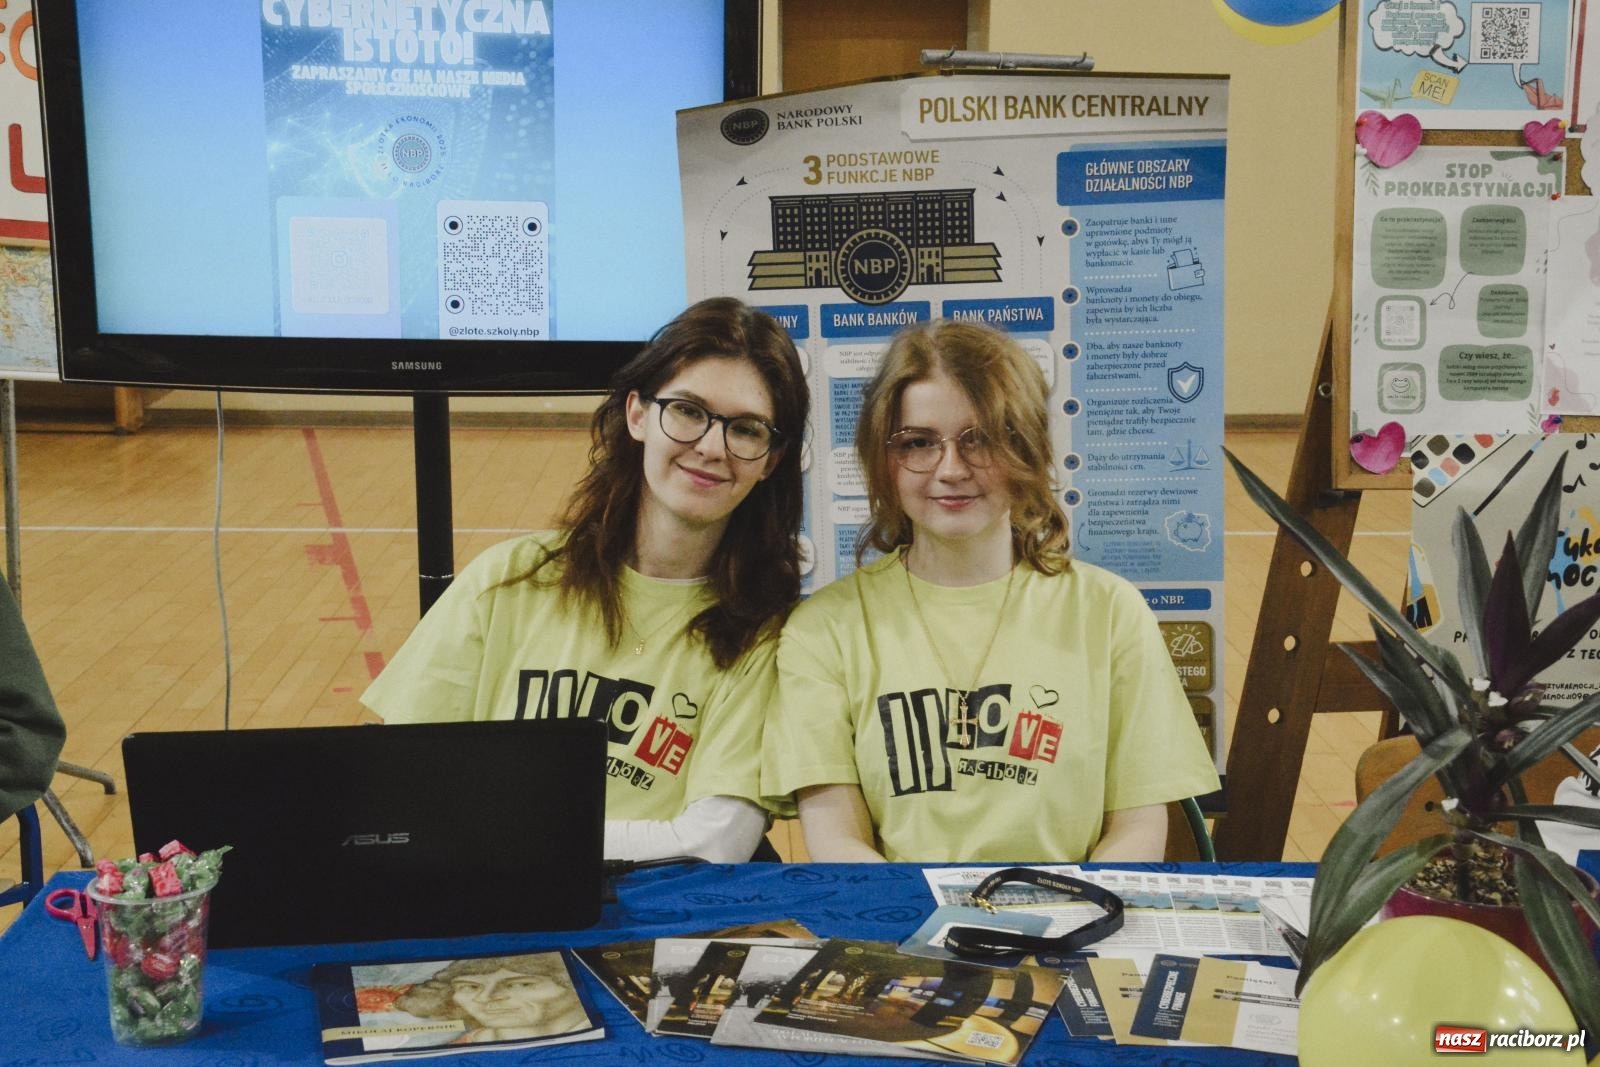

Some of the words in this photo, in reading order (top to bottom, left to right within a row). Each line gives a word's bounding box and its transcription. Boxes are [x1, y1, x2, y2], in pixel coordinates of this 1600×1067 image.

[262, 0, 551, 34] CYBERNETYCZNA
[343, 27, 474, 65] ISTOTO!
[291, 65, 387, 82] ZAPRASZAMY
[413, 69, 433, 84] NA
[1422, 72, 1450, 87] SCAN
[1418, 83, 1446, 101] ME!
[777, 104, 853, 120] NARODOWY
[919, 95, 998, 124] POLSKI
[1004, 94, 1067, 120] BANK
[1072, 94, 1210, 118] CENTRALNY
[732, 120, 759, 130] NBP
[777, 118, 812, 131] BANK
[817, 115, 863, 128] POLSKI
[401, 149, 424, 158] NBP
[826, 150, 940, 167] PODSTAWOWE
[803, 154, 823, 185] 3
[1086, 158, 1134, 176] GŁÓWNE
[1137, 159, 1191, 173] OBSZARY
[1445, 163, 1493, 179] STOP
[827, 168, 898, 185] FUNKCJE
[902, 167, 935, 182] NBP
[1086, 174, 1166, 192] DZIAŁALNOŚCI
[1169, 175, 1193, 189] NBP
[1384, 181, 1554, 198] PROKRASTYNACJI
[854, 258, 896, 275] NBP
[834, 313, 864, 327] BANK
[868, 309, 918, 326] BANKÓW
[953, 309, 985, 323] BANK
[988, 304, 1044, 322] PAŃSTWA
[449, 326, 540, 337] @zlote.szkoly.nbp
[1459, 351, 1473, 361] Czy
[1475, 351, 1500, 361] wiesz,
[391, 361, 442, 370] SAMSUNG
[1160, 595, 1185, 604] NBP.
[1177, 666, 1206, 677] STEGO
[341, 832, 410, 847] ASUS
